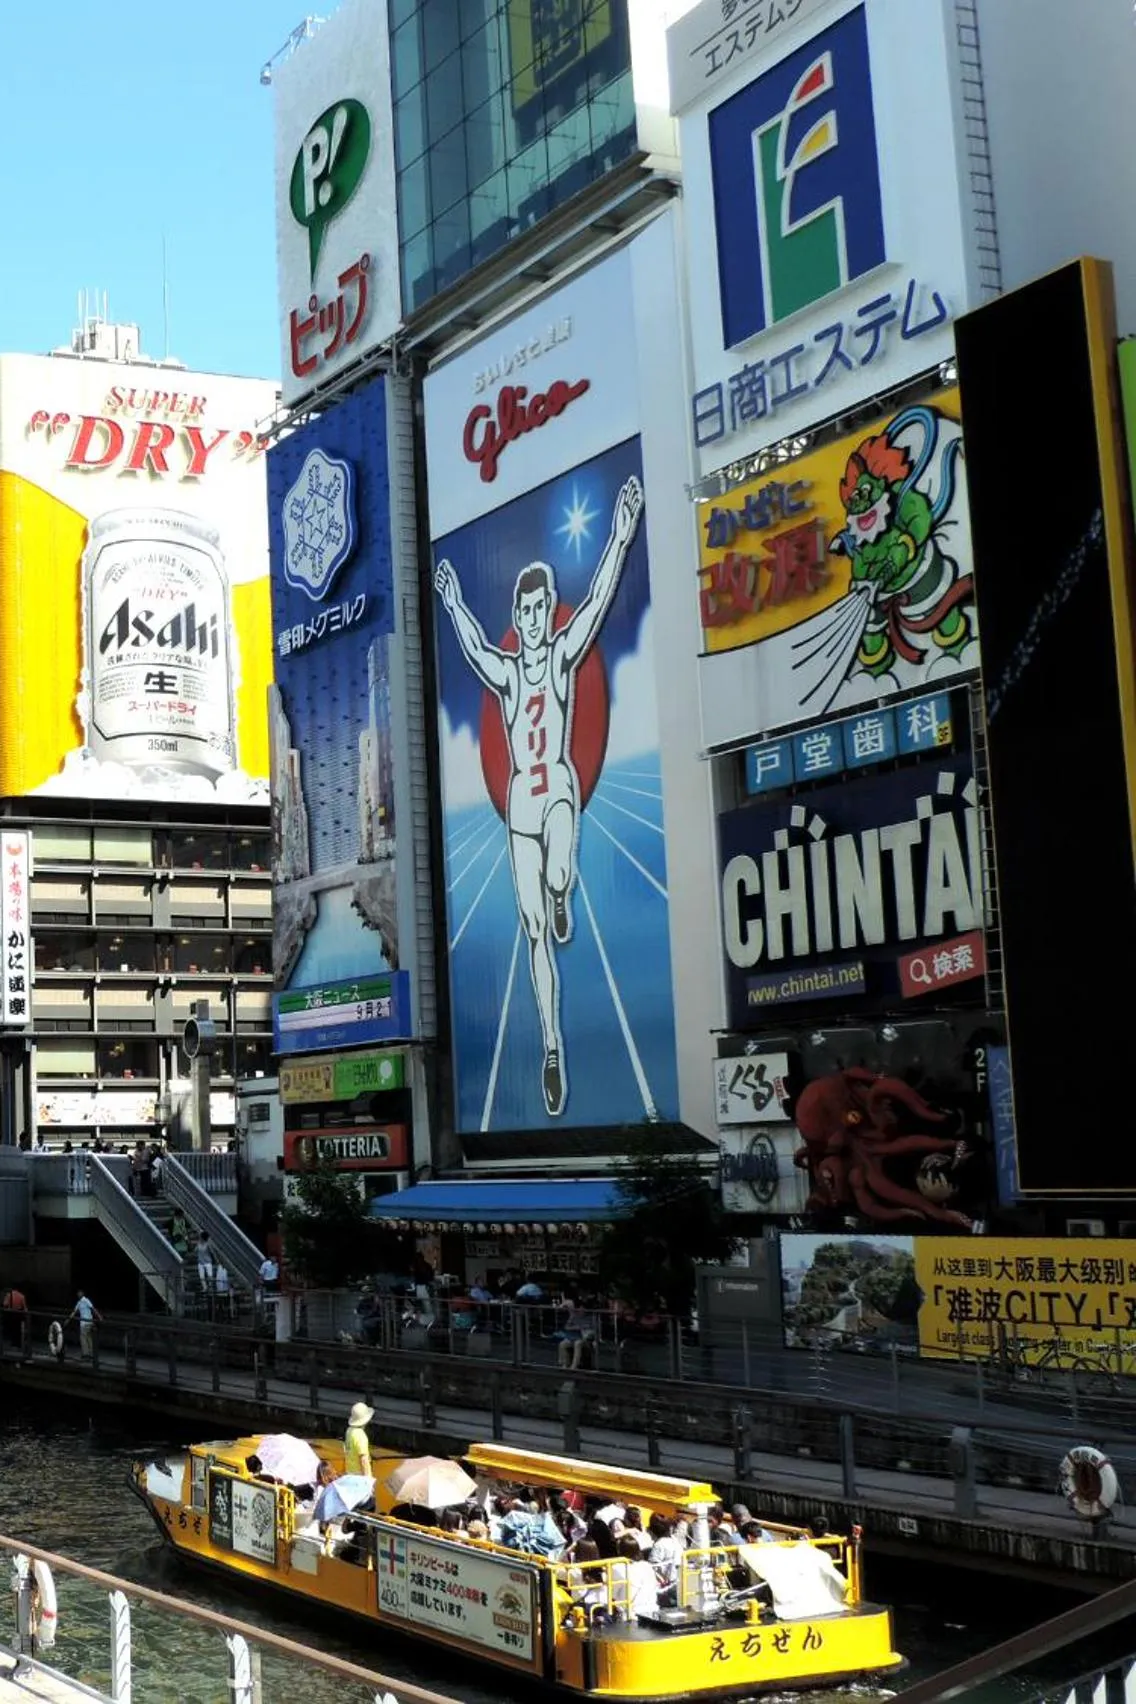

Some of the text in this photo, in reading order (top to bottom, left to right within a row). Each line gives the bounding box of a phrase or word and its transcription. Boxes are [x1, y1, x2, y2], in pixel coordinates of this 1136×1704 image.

[289, 252, 372, 380] ピップ
[691, 277, 951, 449] 日商エステム
[106, 386, 207, 416] SUPER
[462, 378, 591, 483] Glico
[705, 481, 816, 548] かぜに
[700, 516, 832, 628] 改源
[99, 597, 218, 660] Asahi
[278, 593, 366, 657] 雪印メグミルク
[144, 671, 179, 696] 生
[148, 739, 179, 752] 350ml
[524, 686, 551, 797] グリコ
[754, 700, 940, 784] 戸堂歯科
[722, 772, 986, 968] CHINTAI
[7, 930, 26, 1017] かに道楽
[933, 944, 975, 980] 検索
[305, 985, 361, 1009] 大阪ニュース
[316, 1136, 383, 1160] LOTTERIA
[709, 1625, 824, 1663] えちぜん
